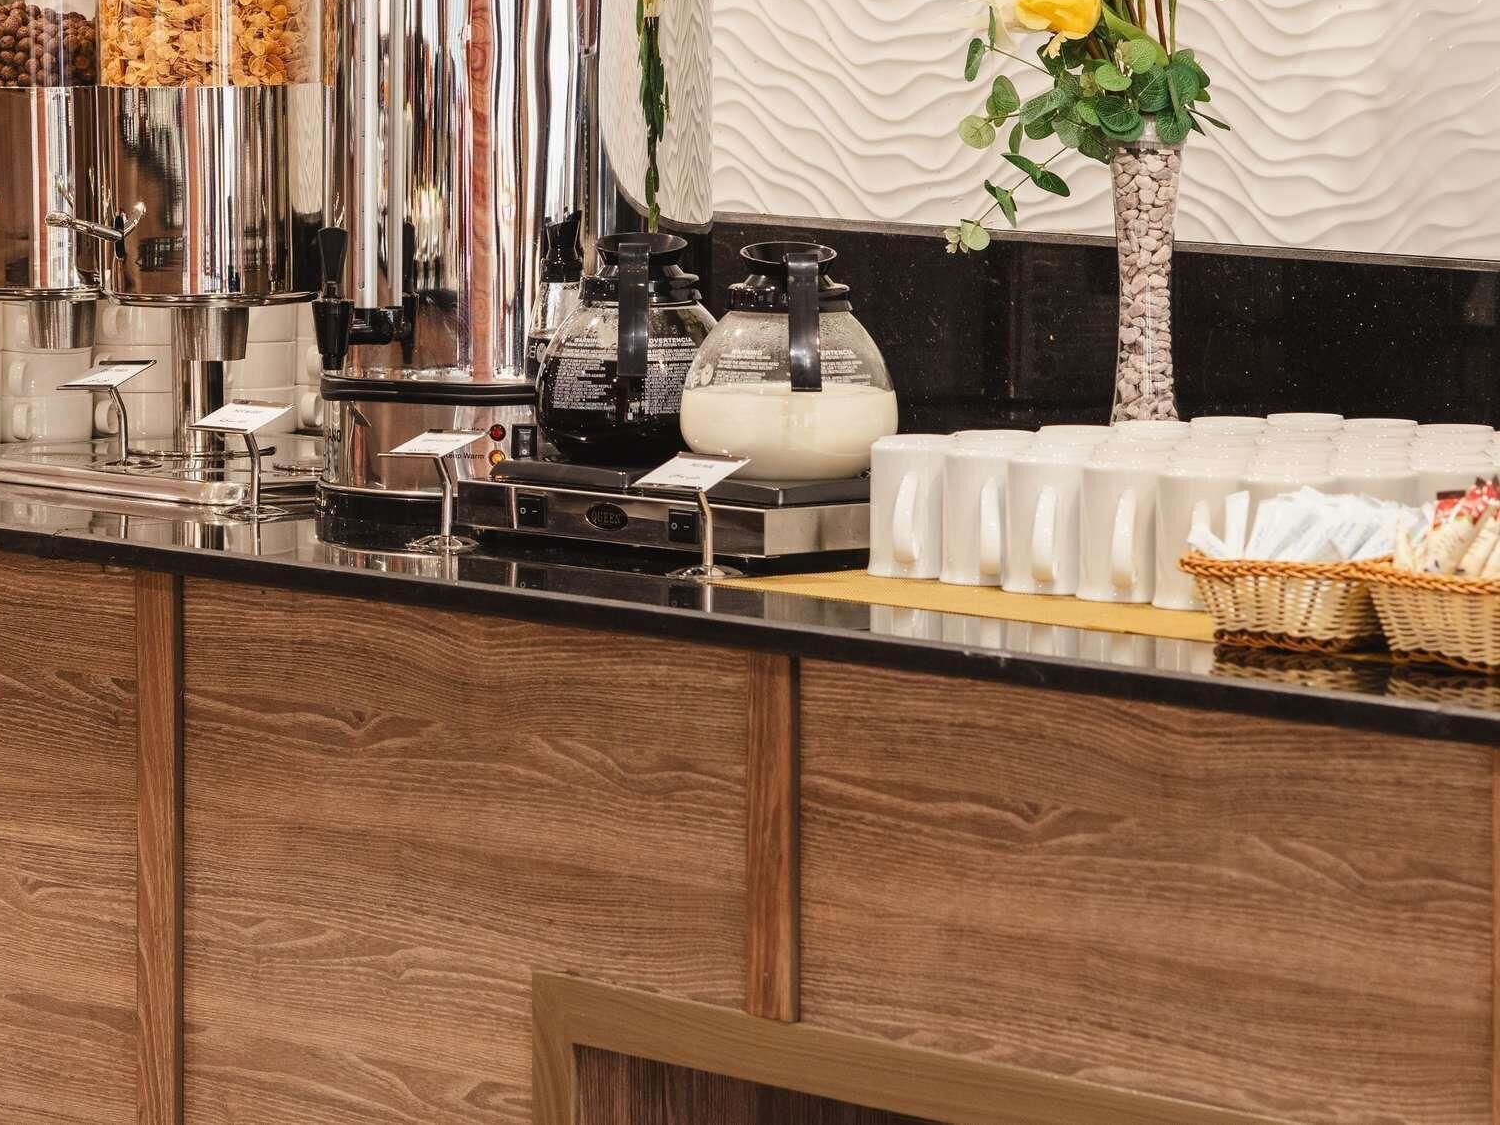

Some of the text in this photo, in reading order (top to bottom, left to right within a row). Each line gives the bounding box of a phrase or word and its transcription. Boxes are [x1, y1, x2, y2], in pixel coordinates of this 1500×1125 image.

[648, 336, 693, 344] DVERTENCIA
[820, 348, 854, 356] ERTENCIA
[463, 451, 485, 459] Warm
[591, 508, 620, 524] QUEEN
